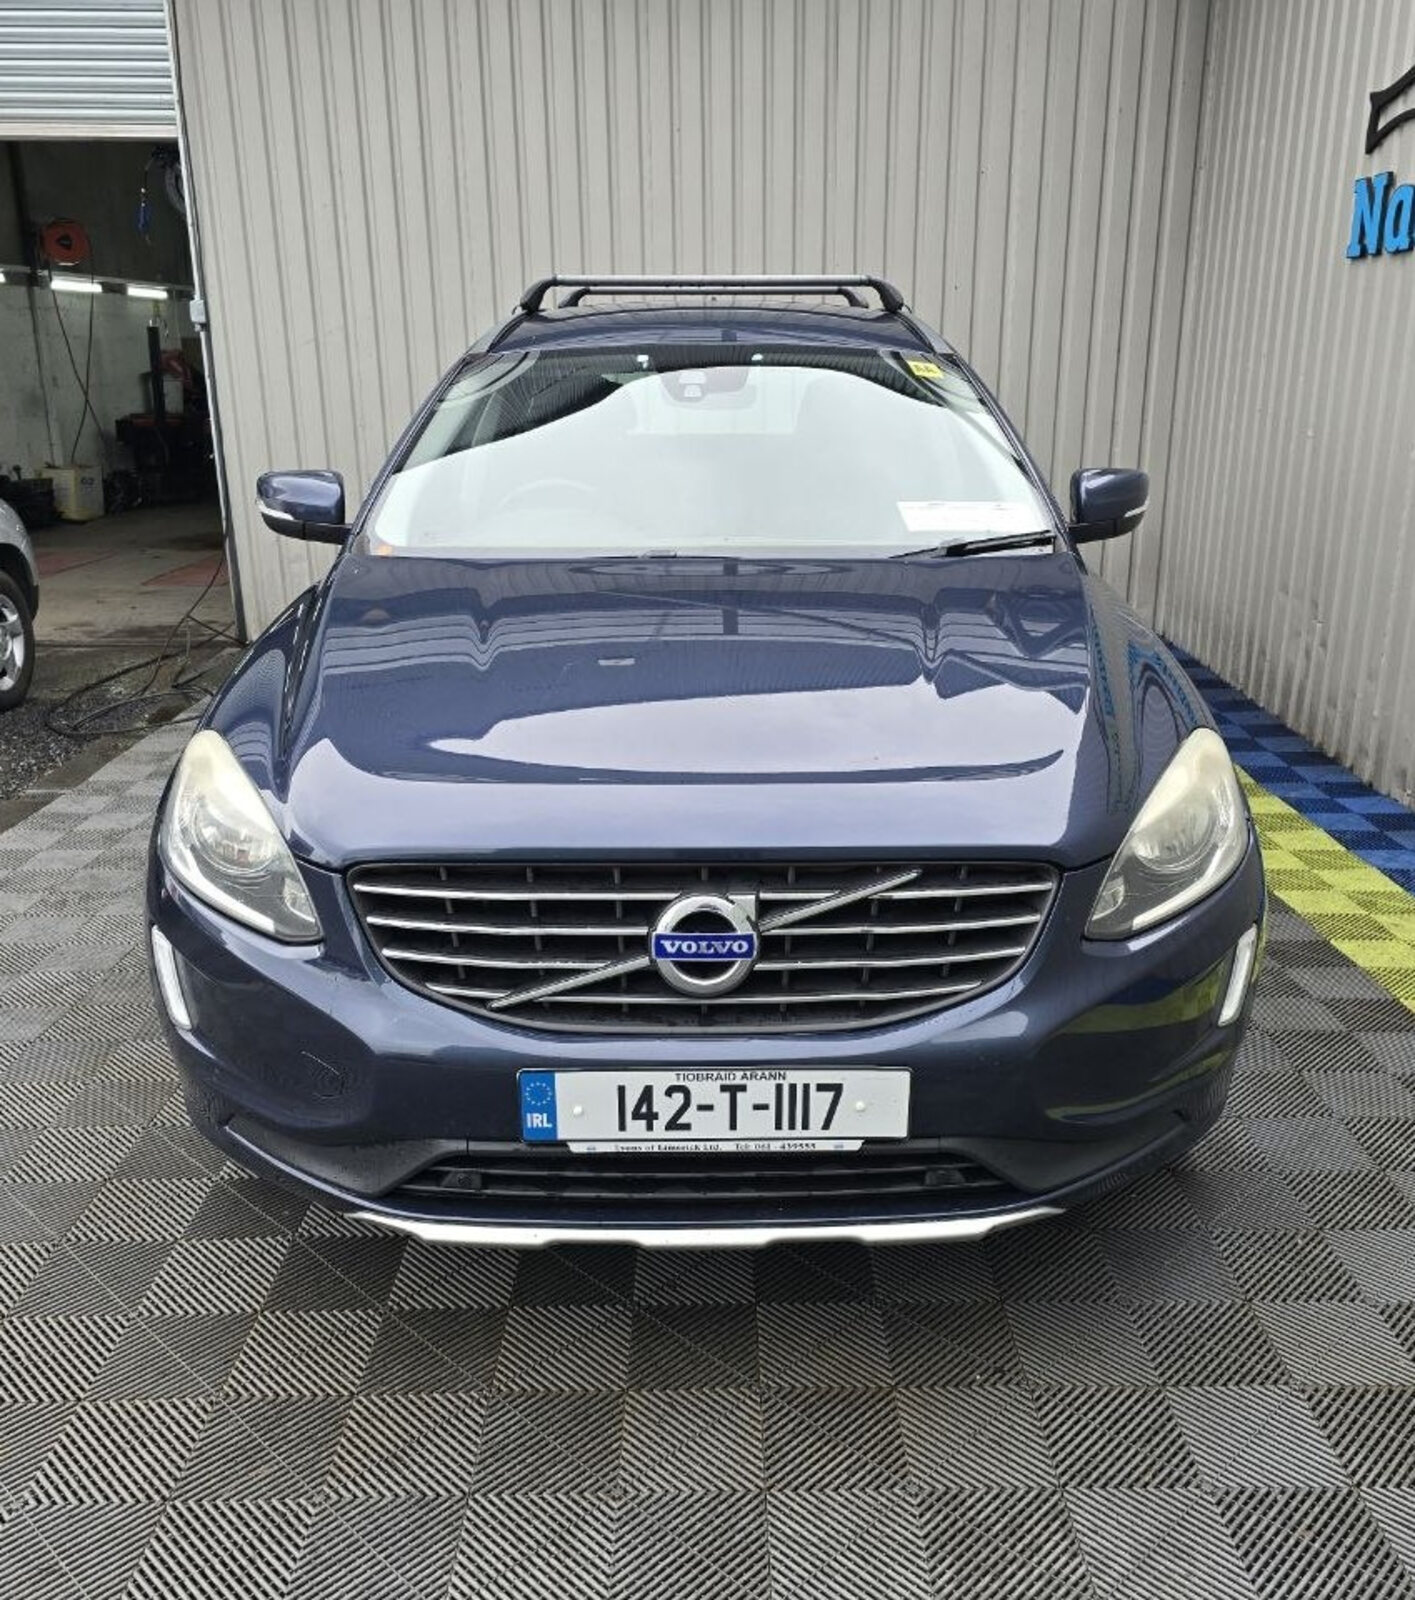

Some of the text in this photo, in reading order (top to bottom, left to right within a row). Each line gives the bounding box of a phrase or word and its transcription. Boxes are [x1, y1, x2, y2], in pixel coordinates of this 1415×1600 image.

[1346, 171, 1415, 259] Na
[660, 940, 749, 954] VOLVO
[675, 1071, 786, 1083] TIOBRAID ARANN
[616, 1083, 844, 1133] 142-T-1117
[526, 1113, 552, 1128] IRL
